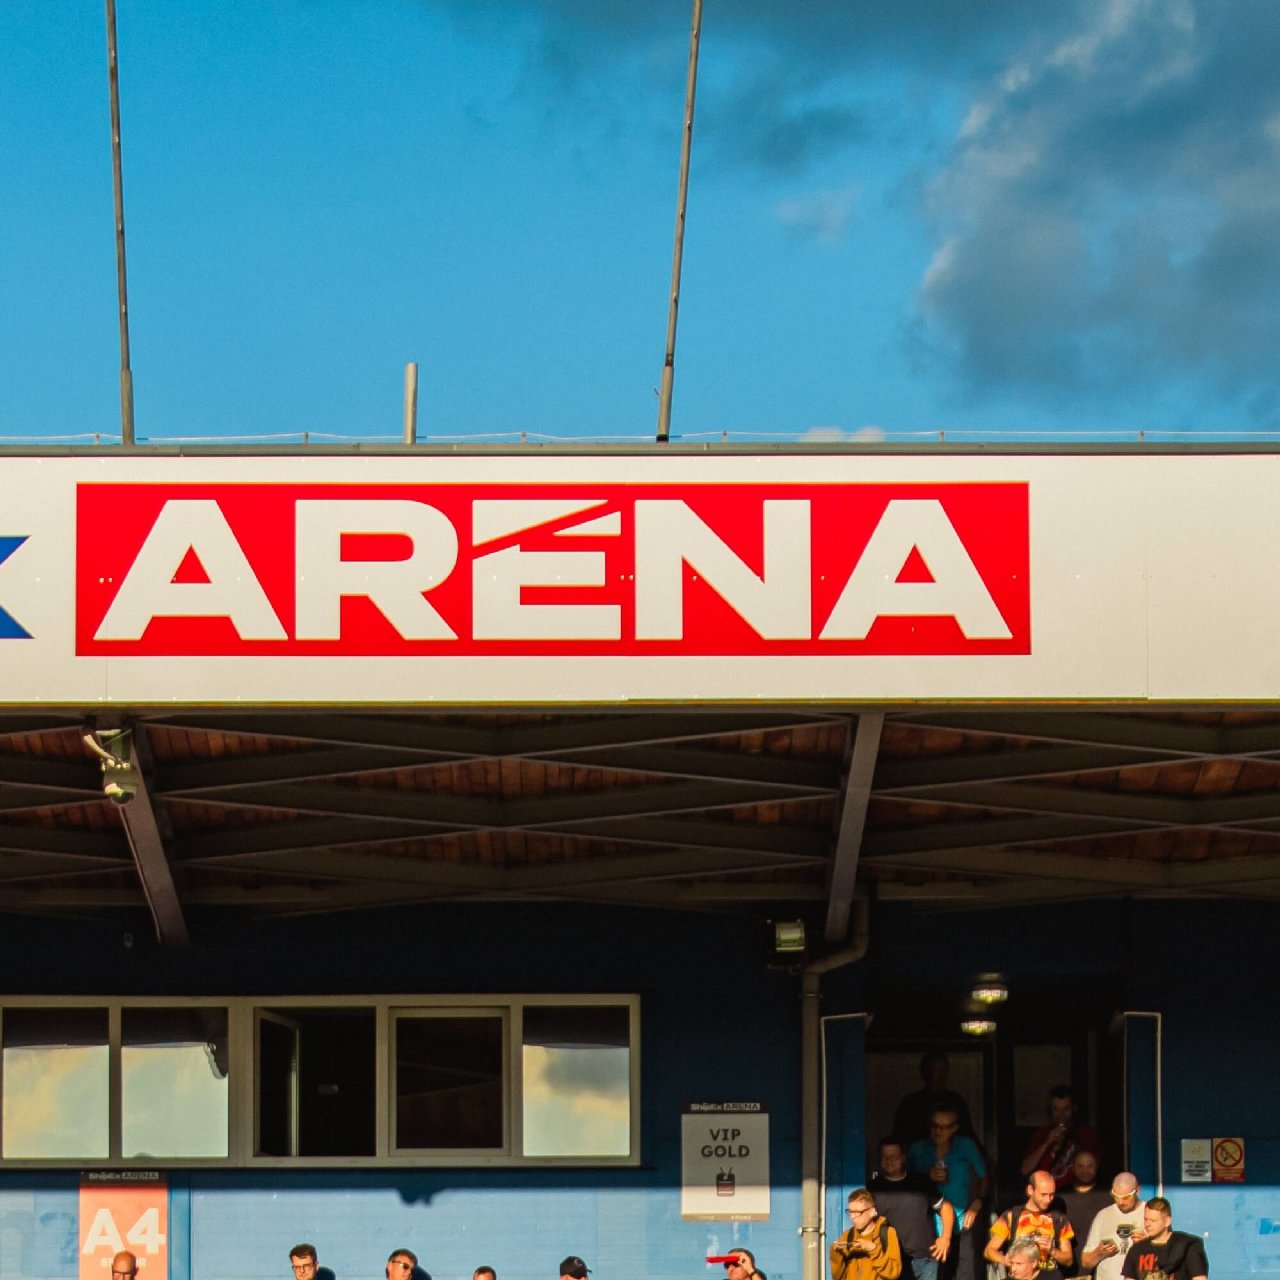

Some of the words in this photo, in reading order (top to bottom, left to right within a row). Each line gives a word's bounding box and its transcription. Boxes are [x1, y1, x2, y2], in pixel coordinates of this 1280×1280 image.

[93, 498, 1014, 641] ARENA
[709, 1128, 741, 1141] VIP
[701, 1145, 750, 1158] GOLD
[82, 1208, 166, 1254] A4
